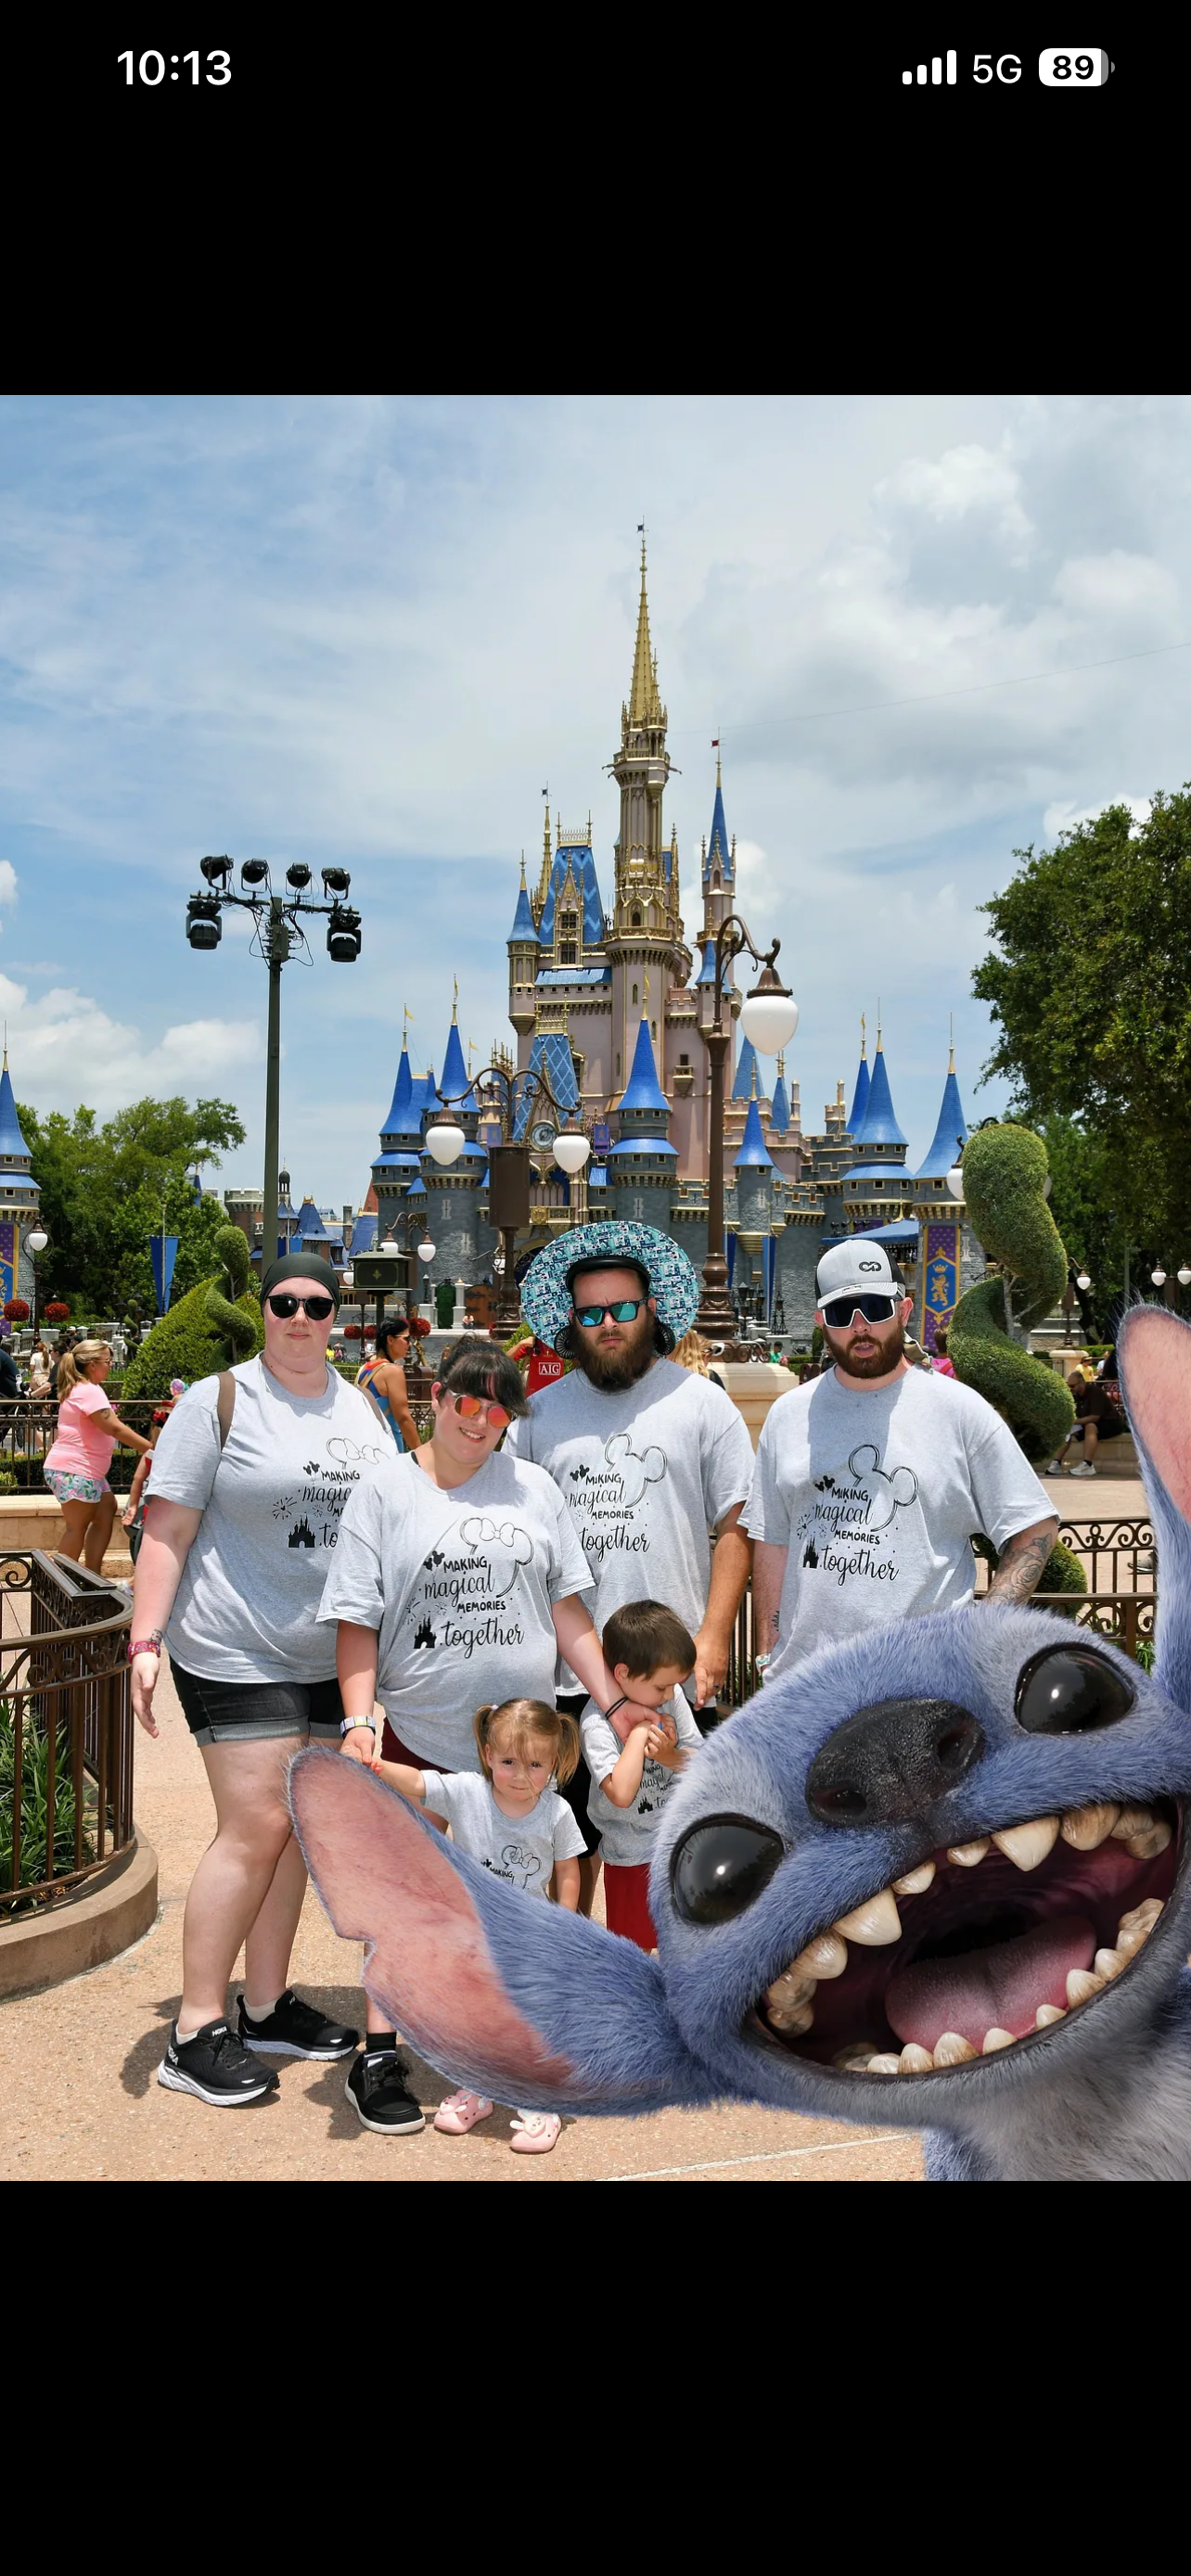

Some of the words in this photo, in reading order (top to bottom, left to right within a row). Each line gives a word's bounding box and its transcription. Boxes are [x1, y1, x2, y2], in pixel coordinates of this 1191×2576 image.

[540, 1364, 559, 1373] AIG
[321, 1470, 360, 1482] MAKING
[301, 1481, 352, 1511] magic
[569, 1480, 626, 1514] magical
[591, 1511, 634, 1520] MEMORIES
[814, 1498, 873, 1533] magical
[579, 1524, 650, 1562] together
[834, 1529, 880, 1545] MEMORIES
[442, 1556, 487, 1573] MAKING
[822, 1545, 900, 1586] together
[425, 1563, 495, 1607] magical
[457, 1600, 506, 1613] MEMORIES
[441, 1617, 525, 1659] together
[211, 2025, 227, 2036] HOKA
